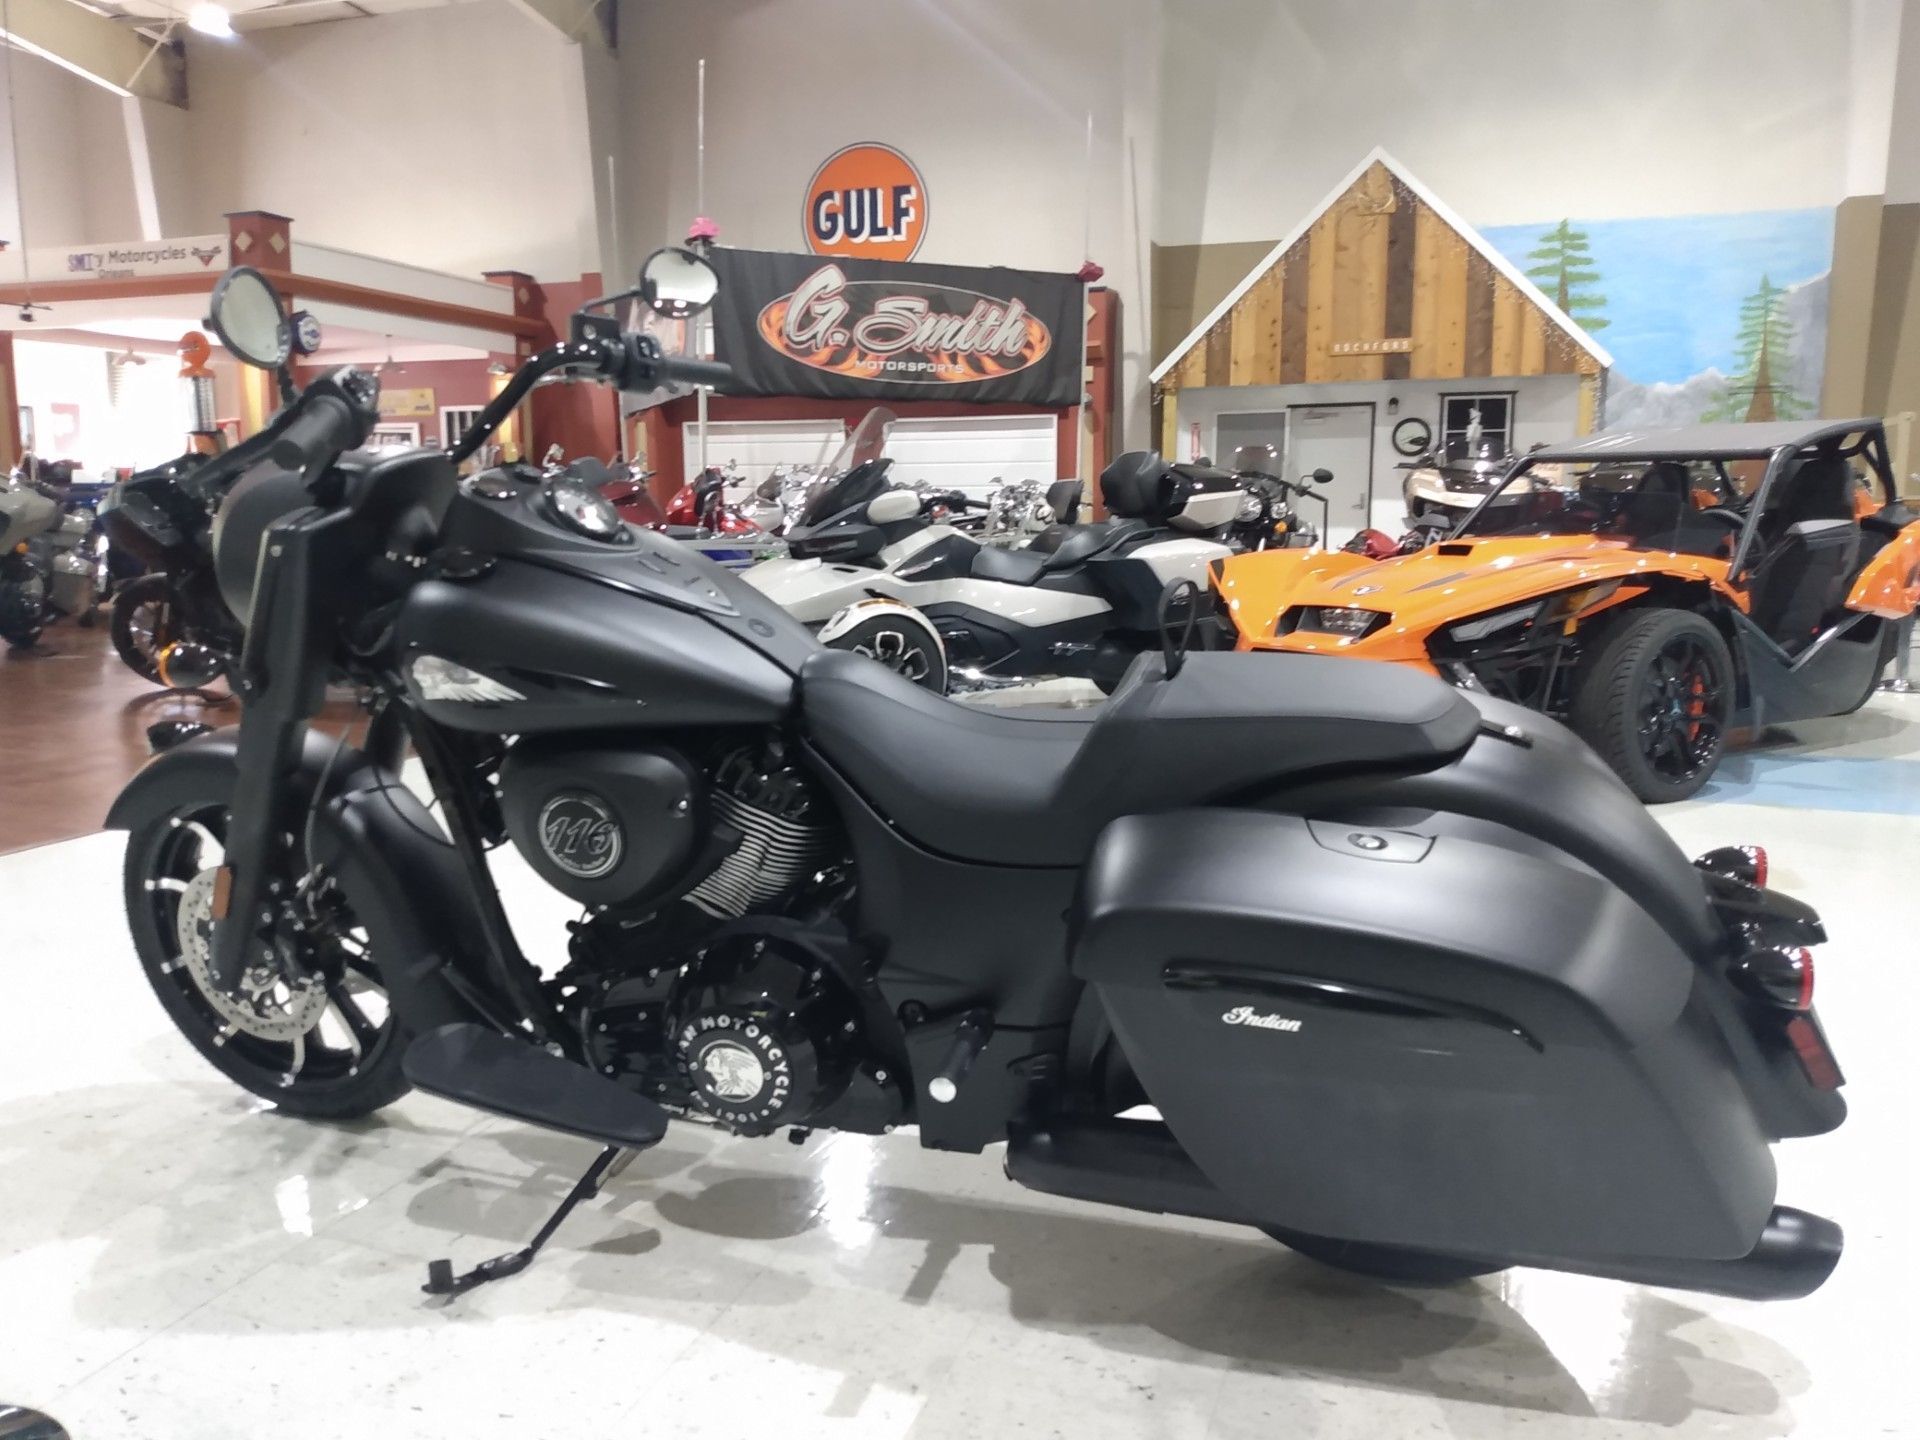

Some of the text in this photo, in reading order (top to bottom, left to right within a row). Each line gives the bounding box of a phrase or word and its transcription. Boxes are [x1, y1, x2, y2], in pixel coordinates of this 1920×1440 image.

[813, 185, 916, 245] GULF
[108, 246, 187, 264] Motorcycles
[853, 296, 1027, 356] Smith
[854, 360, 965, 374] MOTORSPORTS
[546, 816, 615, 855] 116
[1221, 1006, 1302, 1032] Indian
[701, 1014, 790, 1109] MOTORCYCLE
